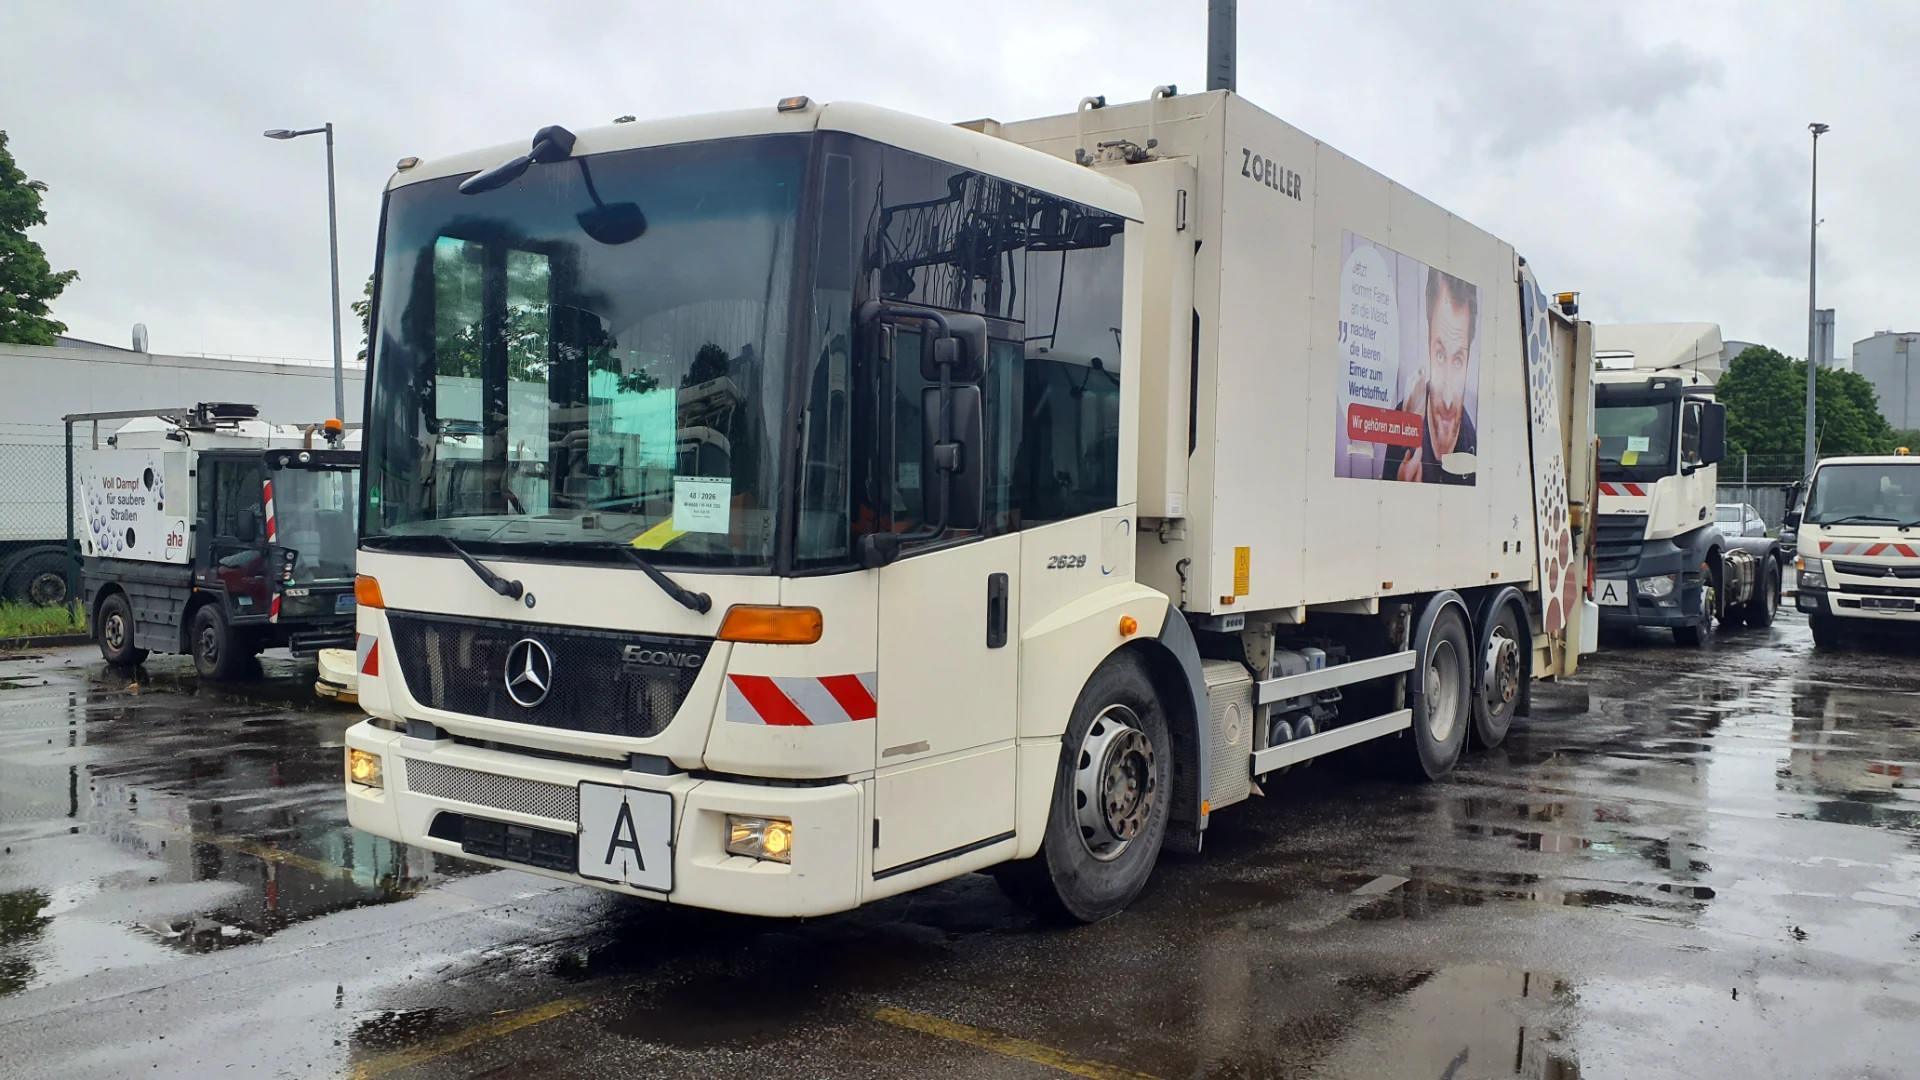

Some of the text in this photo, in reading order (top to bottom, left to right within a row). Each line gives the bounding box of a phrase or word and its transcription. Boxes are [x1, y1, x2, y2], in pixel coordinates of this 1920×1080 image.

[1241, 147, 1302, 201] ZOELLER
[1351, 322, 1376, 340] nachher
[1350, 341, 1380, 361] die leeren
[1349, 360, 1382, 381] Eimer zum
[1348, 379, 1389, 402] Wertstoffhof.
[1352, 414, 1419, 437] Wir gehören zum Leben.
[102, 477, 139, 492] Voll Dampf
[106, 493, 145, 506] für saubere
[110, 508, 138, 521] Straßen
[166, 530, 183, 548] aha
[1602, 582, 1618, 602] A
[622, 644, 701, 668] ECONIC
[604, 802, 646, 871] A
